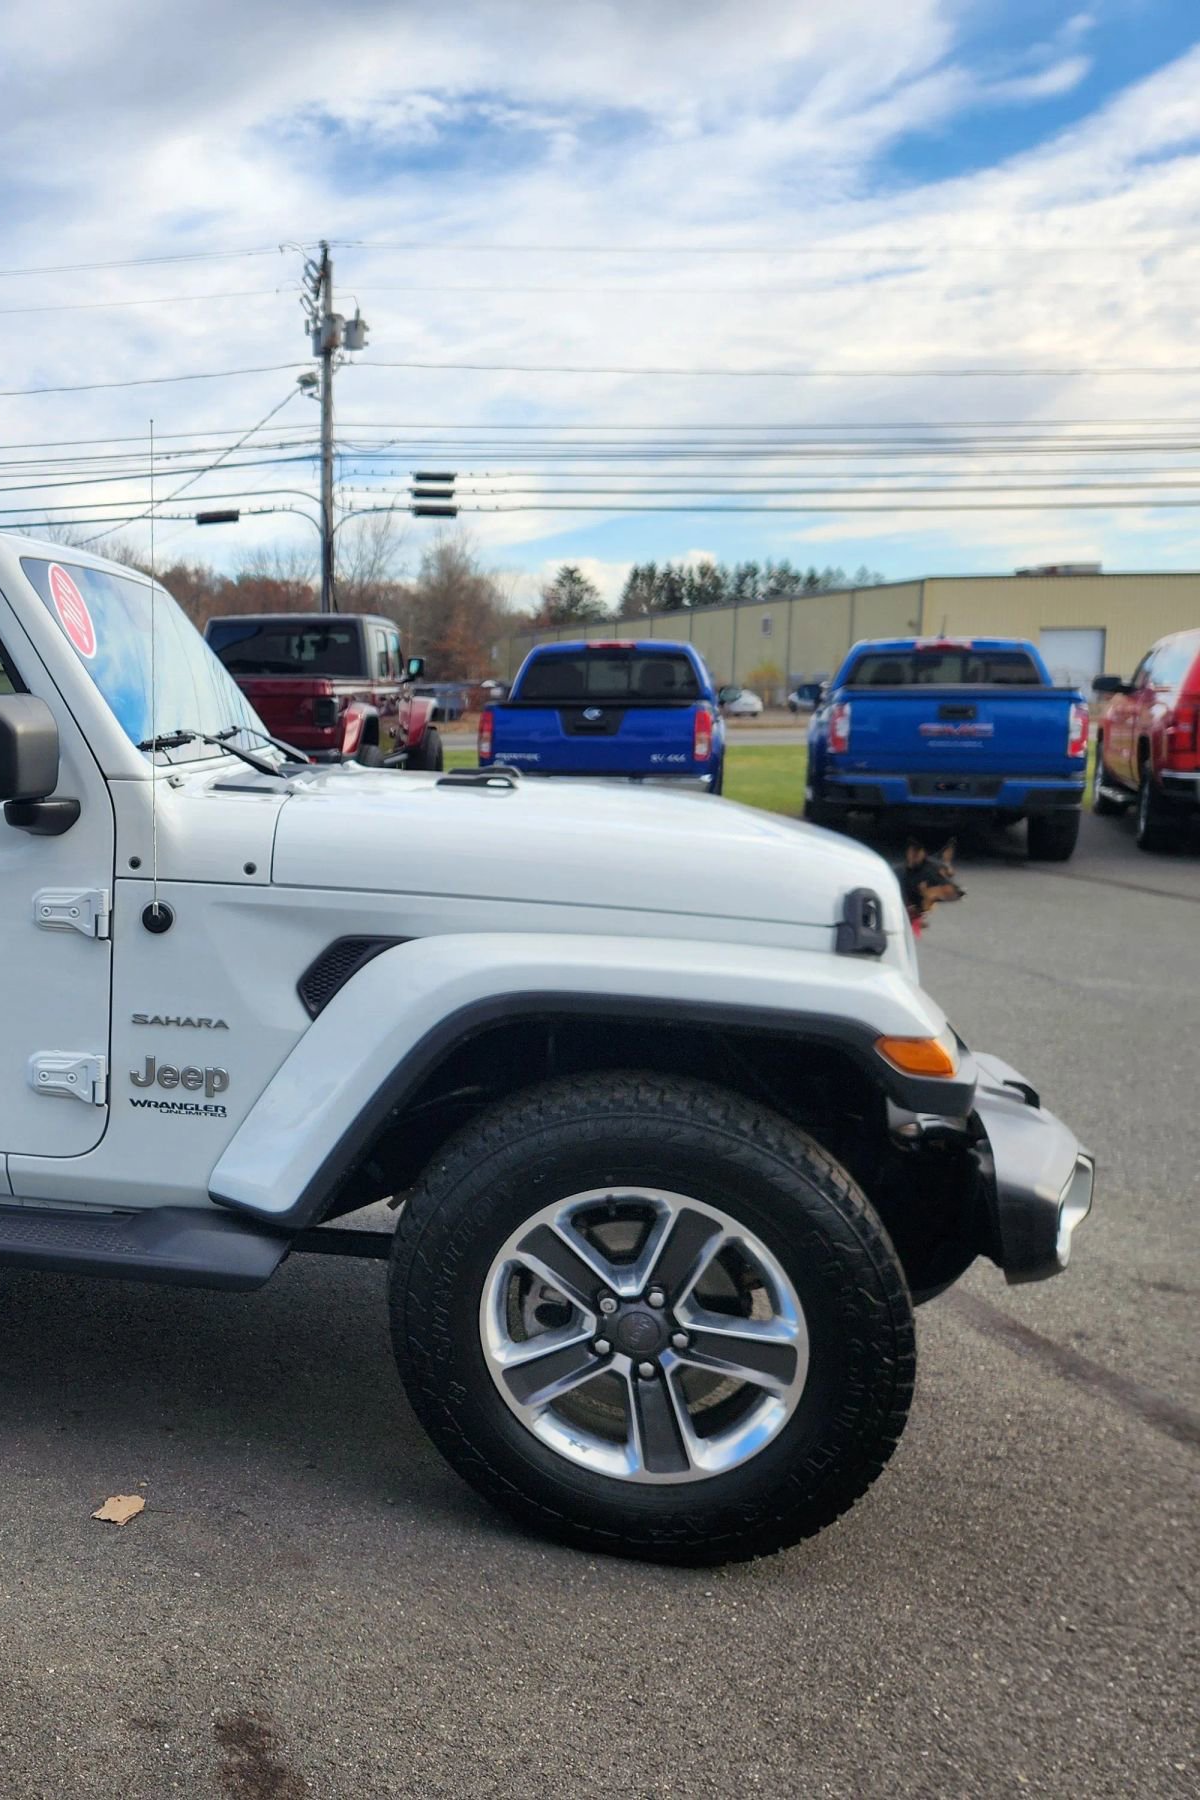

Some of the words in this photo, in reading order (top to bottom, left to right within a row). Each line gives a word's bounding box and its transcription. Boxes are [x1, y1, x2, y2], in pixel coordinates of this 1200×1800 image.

[131, 1014, 229, 1029] SAHARA
[129, 1054, 230, 1098] Jeep
[129, 1098, 226, 1113] WRANGLER
[159, 1108, 228, 1118] UNLIMITED
